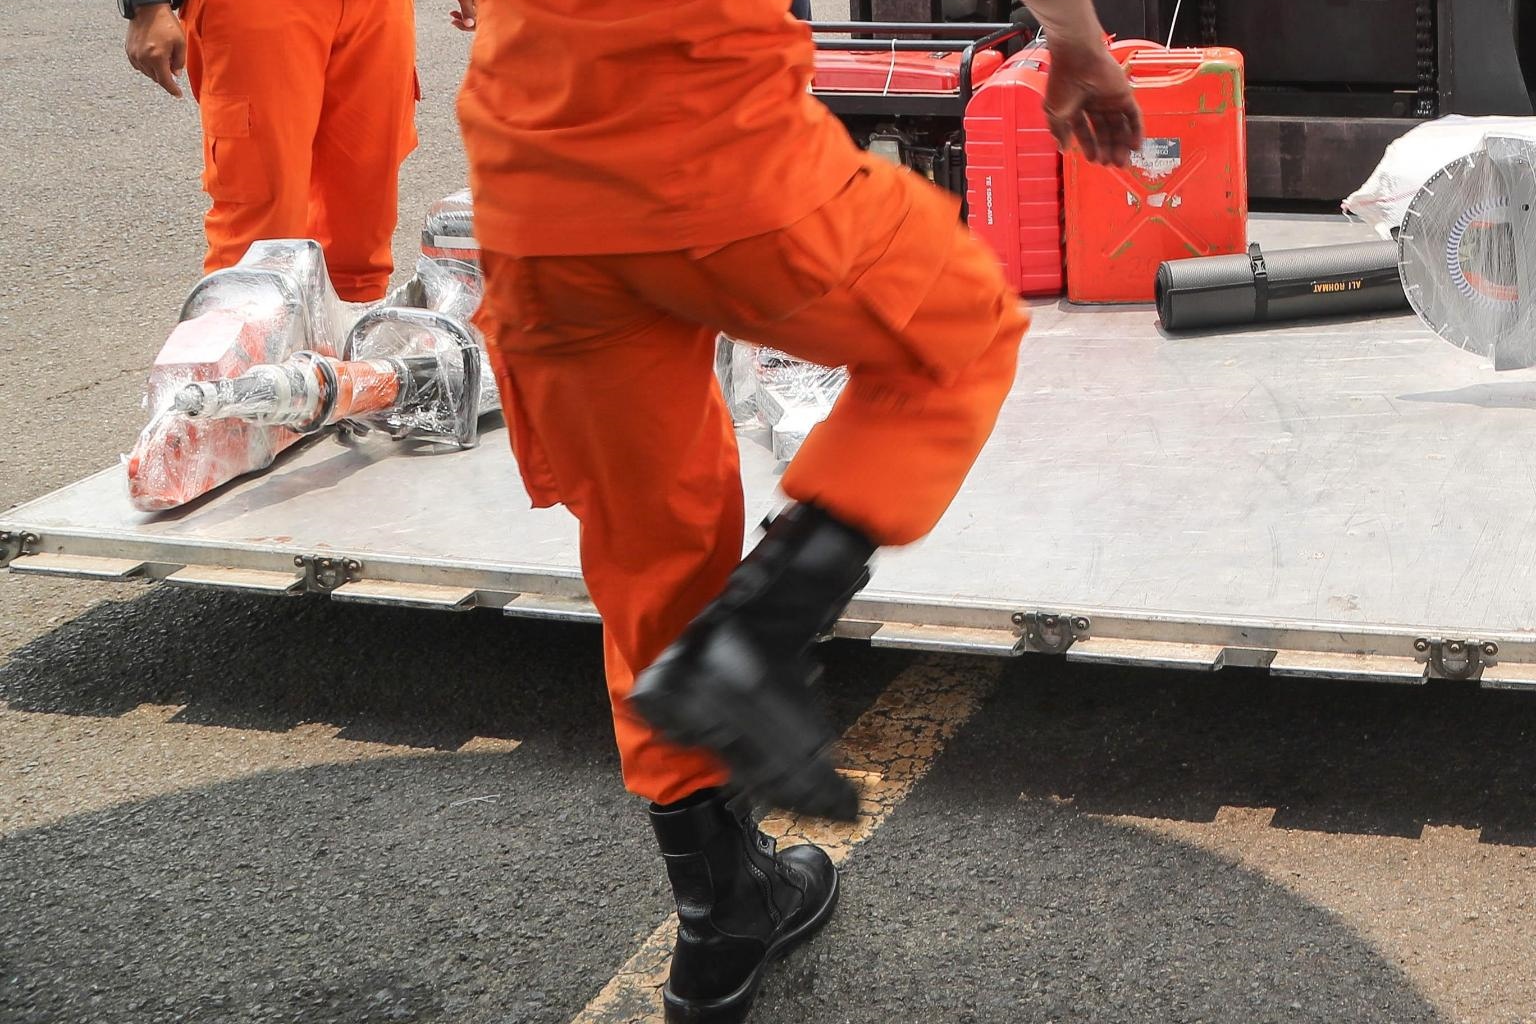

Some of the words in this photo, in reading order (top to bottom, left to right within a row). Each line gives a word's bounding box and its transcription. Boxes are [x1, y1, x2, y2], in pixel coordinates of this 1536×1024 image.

[985, 175, 992, 186] TE
[1312, 282, 1346, 293] ROHMAT
[1348, 280, 1361, 291] ALI
